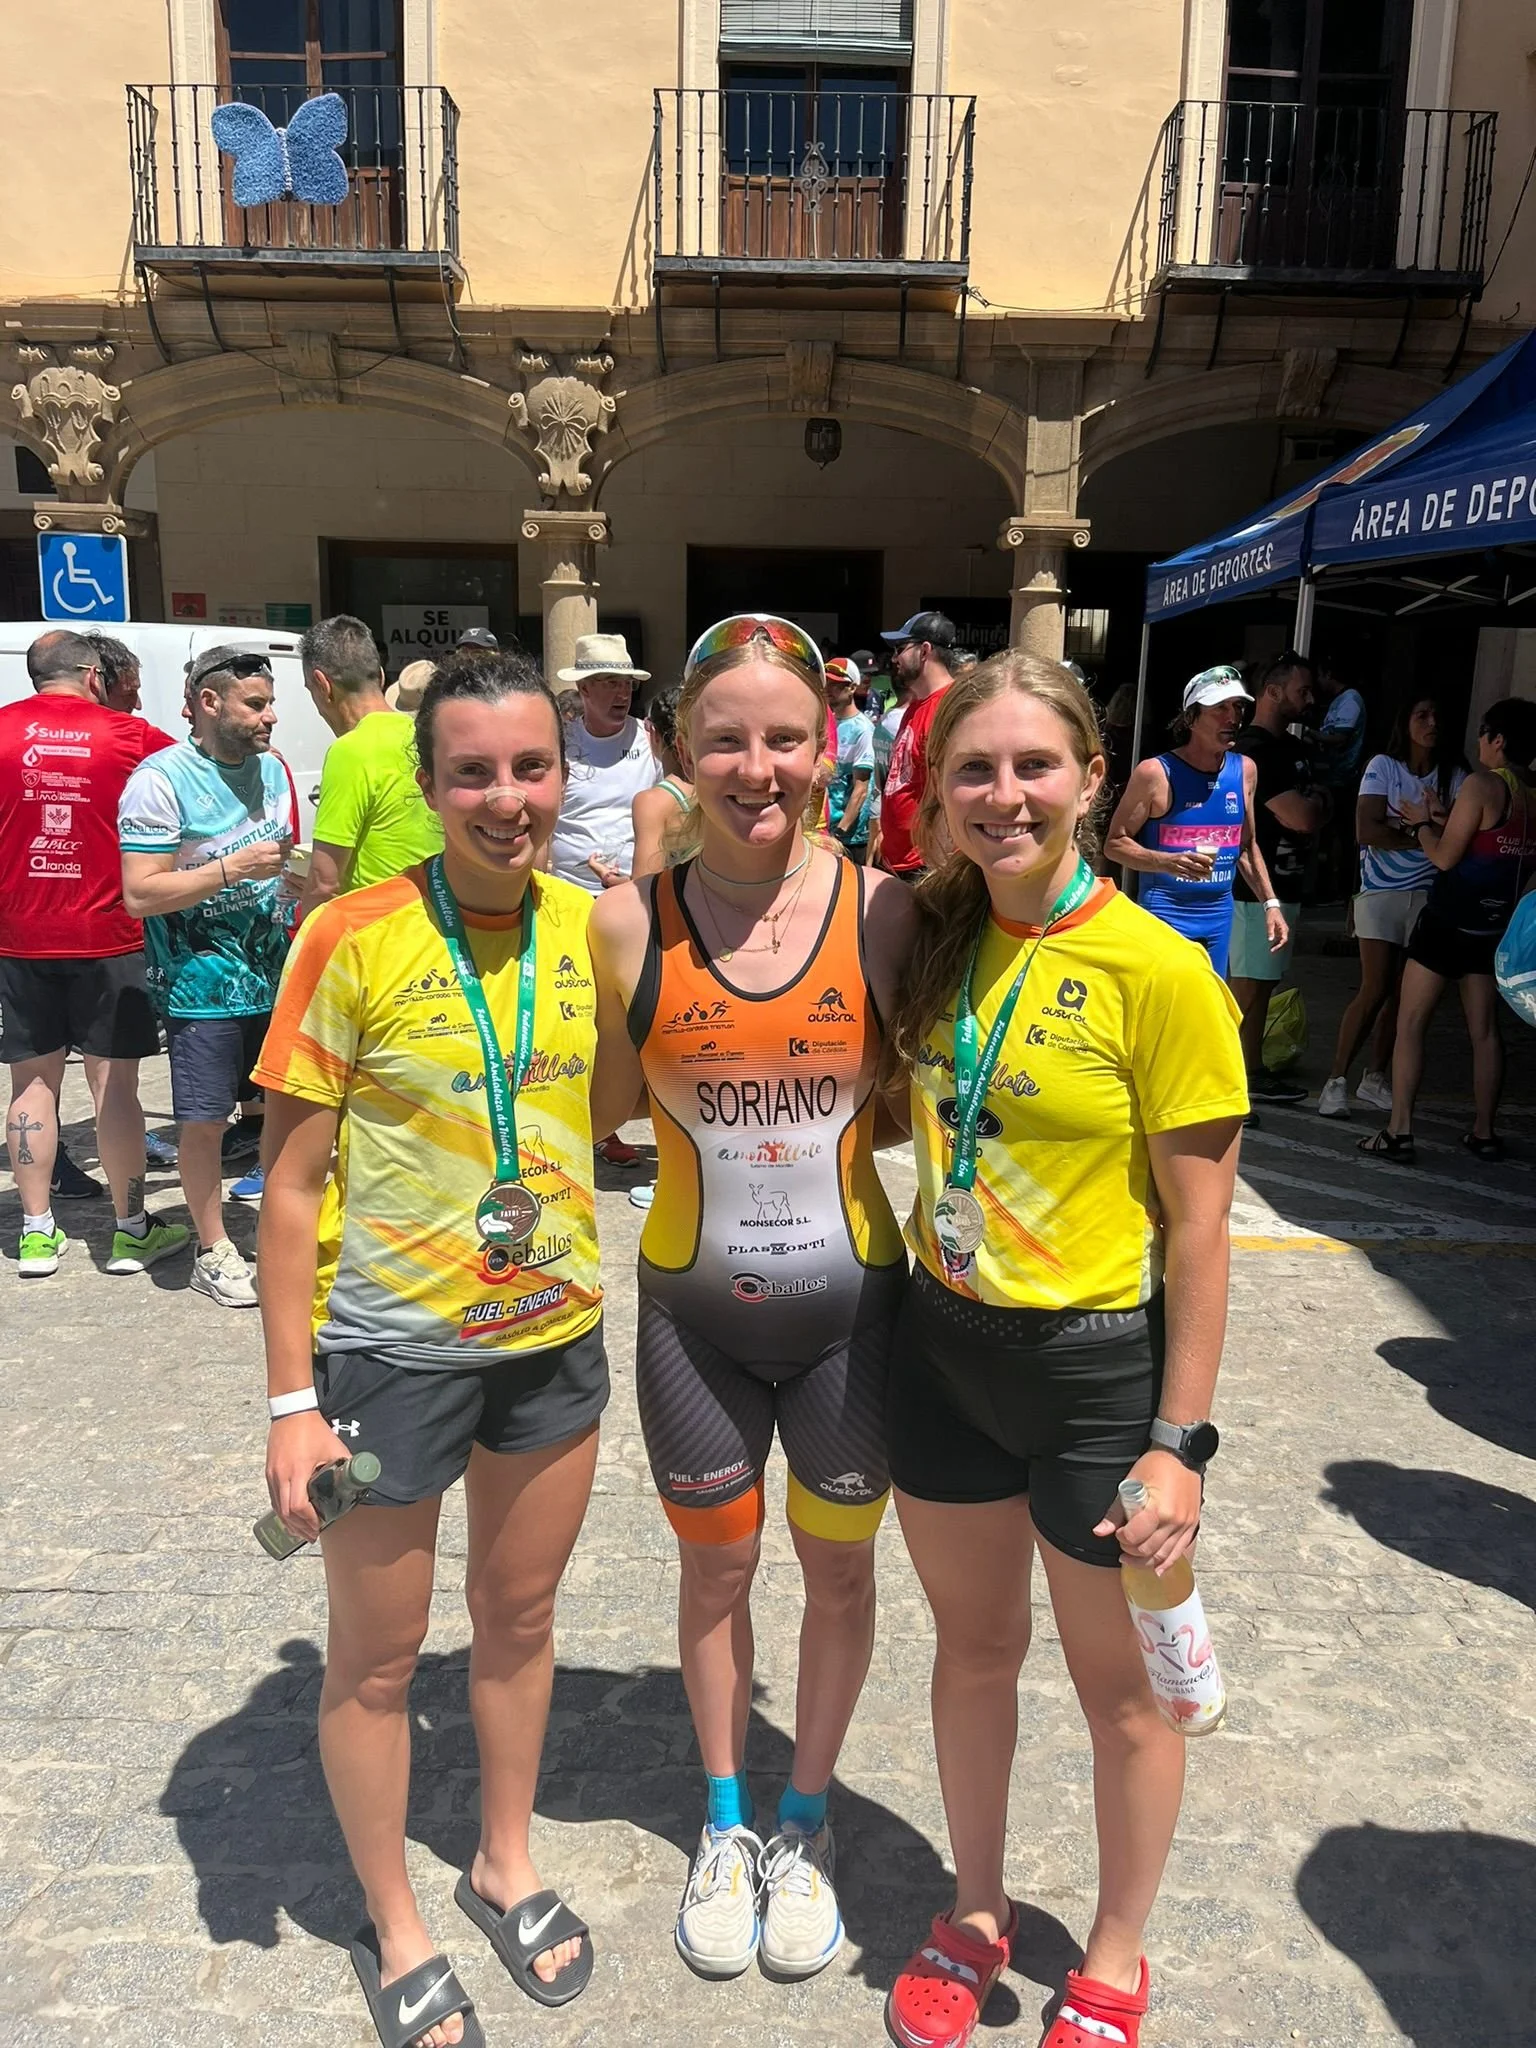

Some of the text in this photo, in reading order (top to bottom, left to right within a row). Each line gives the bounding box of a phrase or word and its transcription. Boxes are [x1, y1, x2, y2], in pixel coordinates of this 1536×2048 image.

[1351, 499, 1409, 542] ÁREA
[1422, 488, 1457, 531] DE
[1162, 542, 1274, 606] ÁREA DE DEPORTES
[423, 610, 450, 626] SE
[390, 629, 463, 648] ALQUI
[38, 727, 91, 742] Sulayr
[1496, 835, 1520, 846] CLUB
[30, 856, 81, 871] aranda
[808, 1013, 857, 1023] austral
[1041, 1006, 1088, 1026] austral
[476, 1007, 497, 1063] Federación
[520, 1008, 531, 1060] Federación
[981, 1019, 1005, 1072] Federación
[490, 1062, 505, 1114] Andaluza
[966, 1072, 987, 1122] Andaluza
[695, 1074, 837, 1129] SORIANO
[497, 1113, 508, 1127] de
[963, 1124, 971, 1137] de
[740, 1216, 811, 1228] MONSECOR S.L.
[728, 1238, 825, 1255] PLASMONTI
[731, 1272, 828, 1302] Ceballos
[463, 1301, 505, 1323] FUEL
[514, 1280, 572, 1316] ENERGY
[669, 1472, 694, 1483] FUEL
[704, 1460, 745, 1481] ENERGY
[820, 1483, 873, 1497] austral
